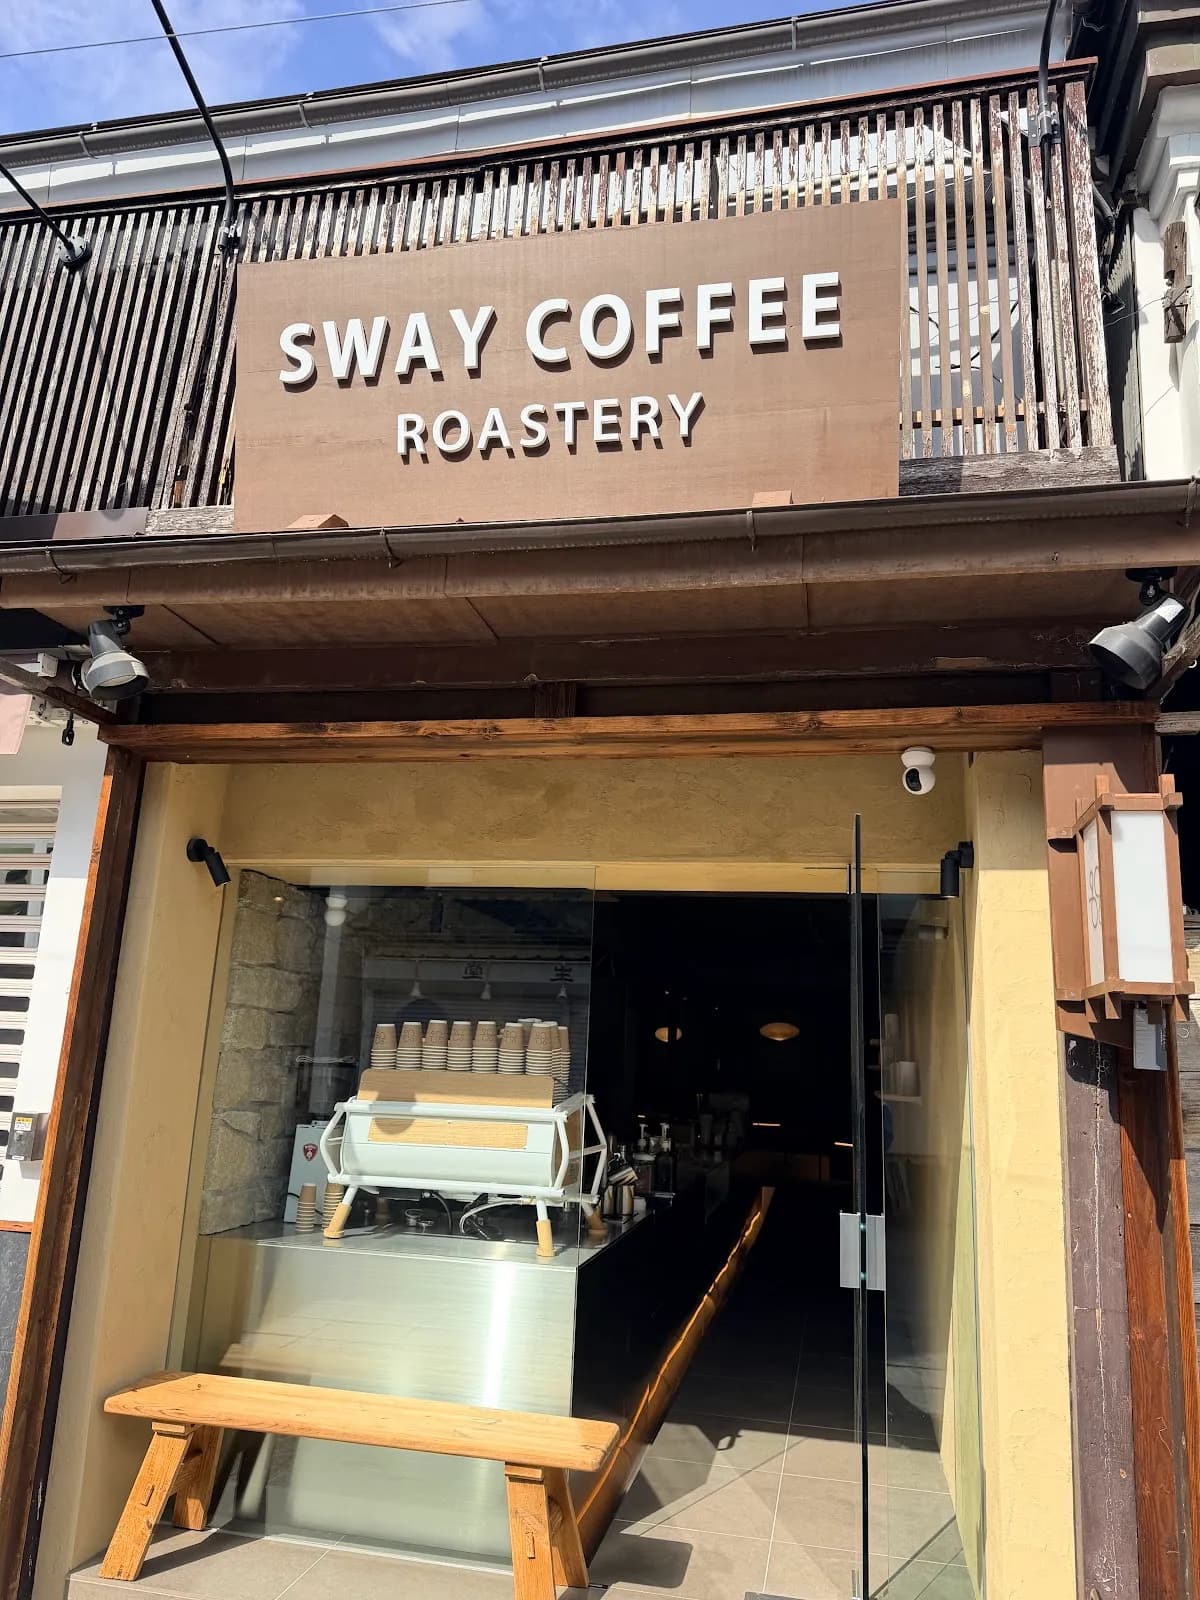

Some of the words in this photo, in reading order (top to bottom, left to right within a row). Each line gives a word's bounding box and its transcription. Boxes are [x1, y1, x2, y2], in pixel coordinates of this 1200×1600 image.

[279, 304, 495, 385] SWAY
[525, 271, 841, 364] COFFEE
[396, 391, 704, 457] ROASTERY
